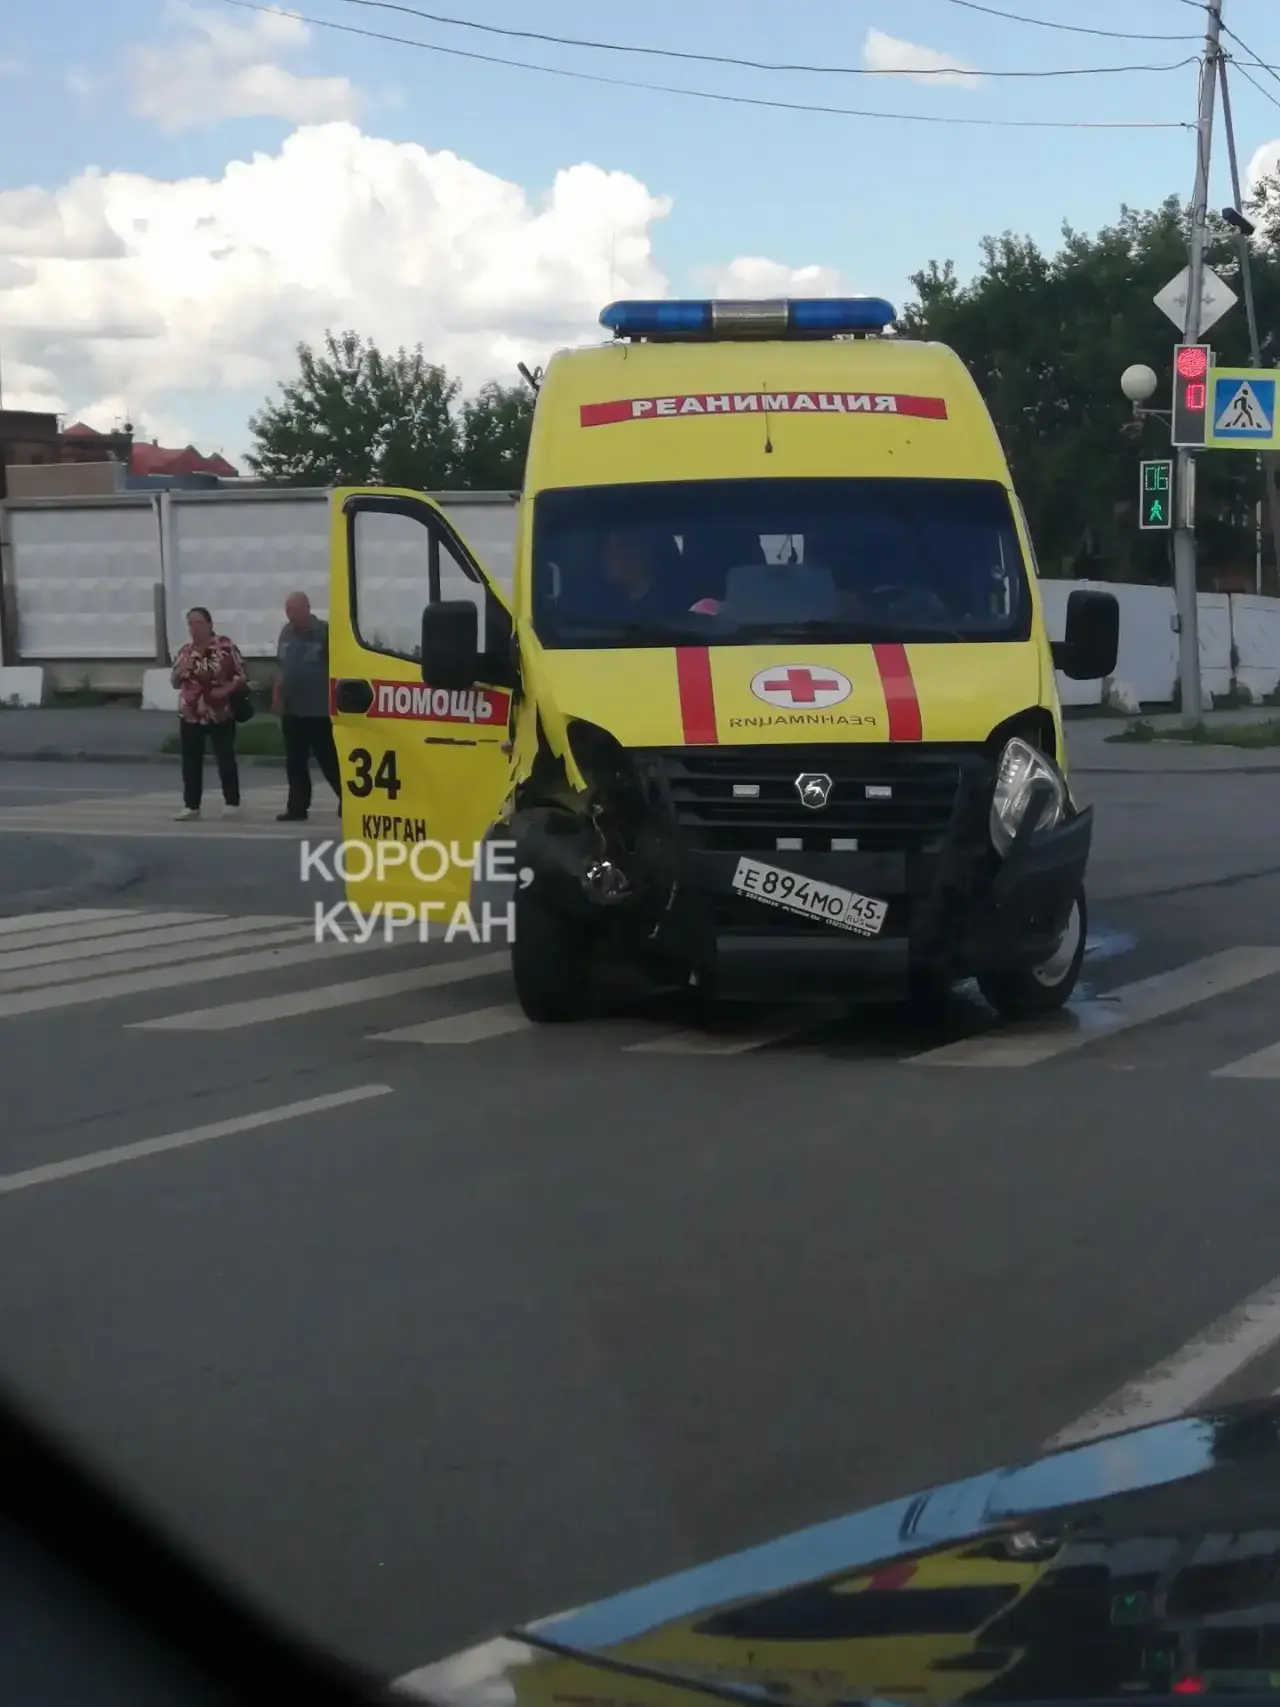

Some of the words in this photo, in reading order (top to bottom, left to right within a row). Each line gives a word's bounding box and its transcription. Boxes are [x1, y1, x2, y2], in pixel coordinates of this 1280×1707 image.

[631, 394, 898, 418] РЕАНИМАЦИЯ
[377, 685, 493, 722] ПОМОЩЬ
[346, 748, 401, 800] 34
[362, 814, 426, 842] КУРГАН
[846, 914, 866, 926] RUS
[852, 898, 878, 920] 45
